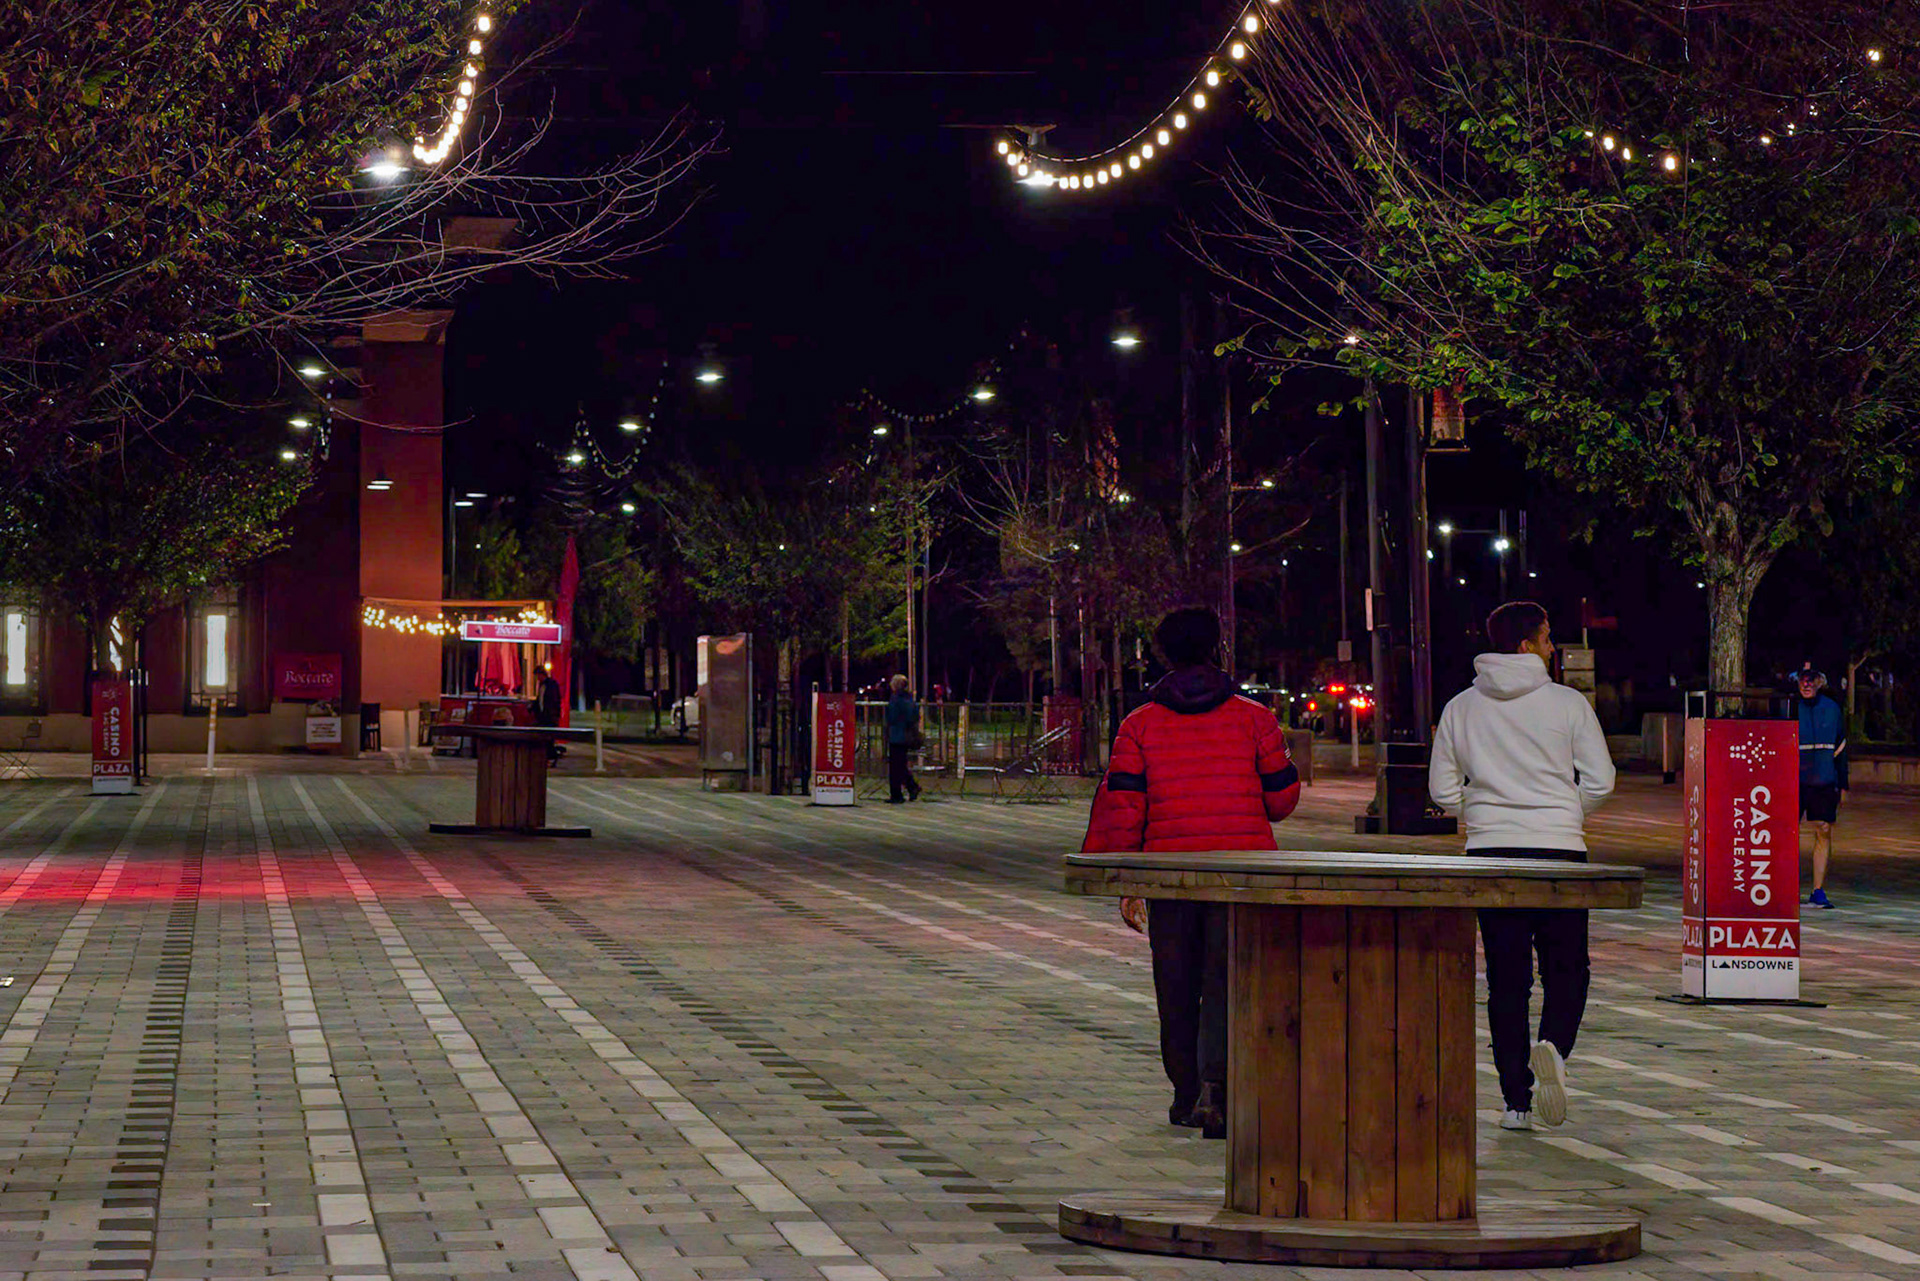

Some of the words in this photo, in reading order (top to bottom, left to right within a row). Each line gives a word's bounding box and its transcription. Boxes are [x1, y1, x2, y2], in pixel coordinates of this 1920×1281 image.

[110, 706, 120, 757] CASINO
[833, 719, 844, 769] CASINO
[93, 763, 130, 774] PLAZA
[817, 775, 852, 786] PLAZA
[1733, 797, 1745, 893] LAC-LEAMY
[1750, 785, 1771, 906] CASINO
[1682, 925, 1703, 948] PLAZA
[1709, 926, 1796, 949] PLAZA
